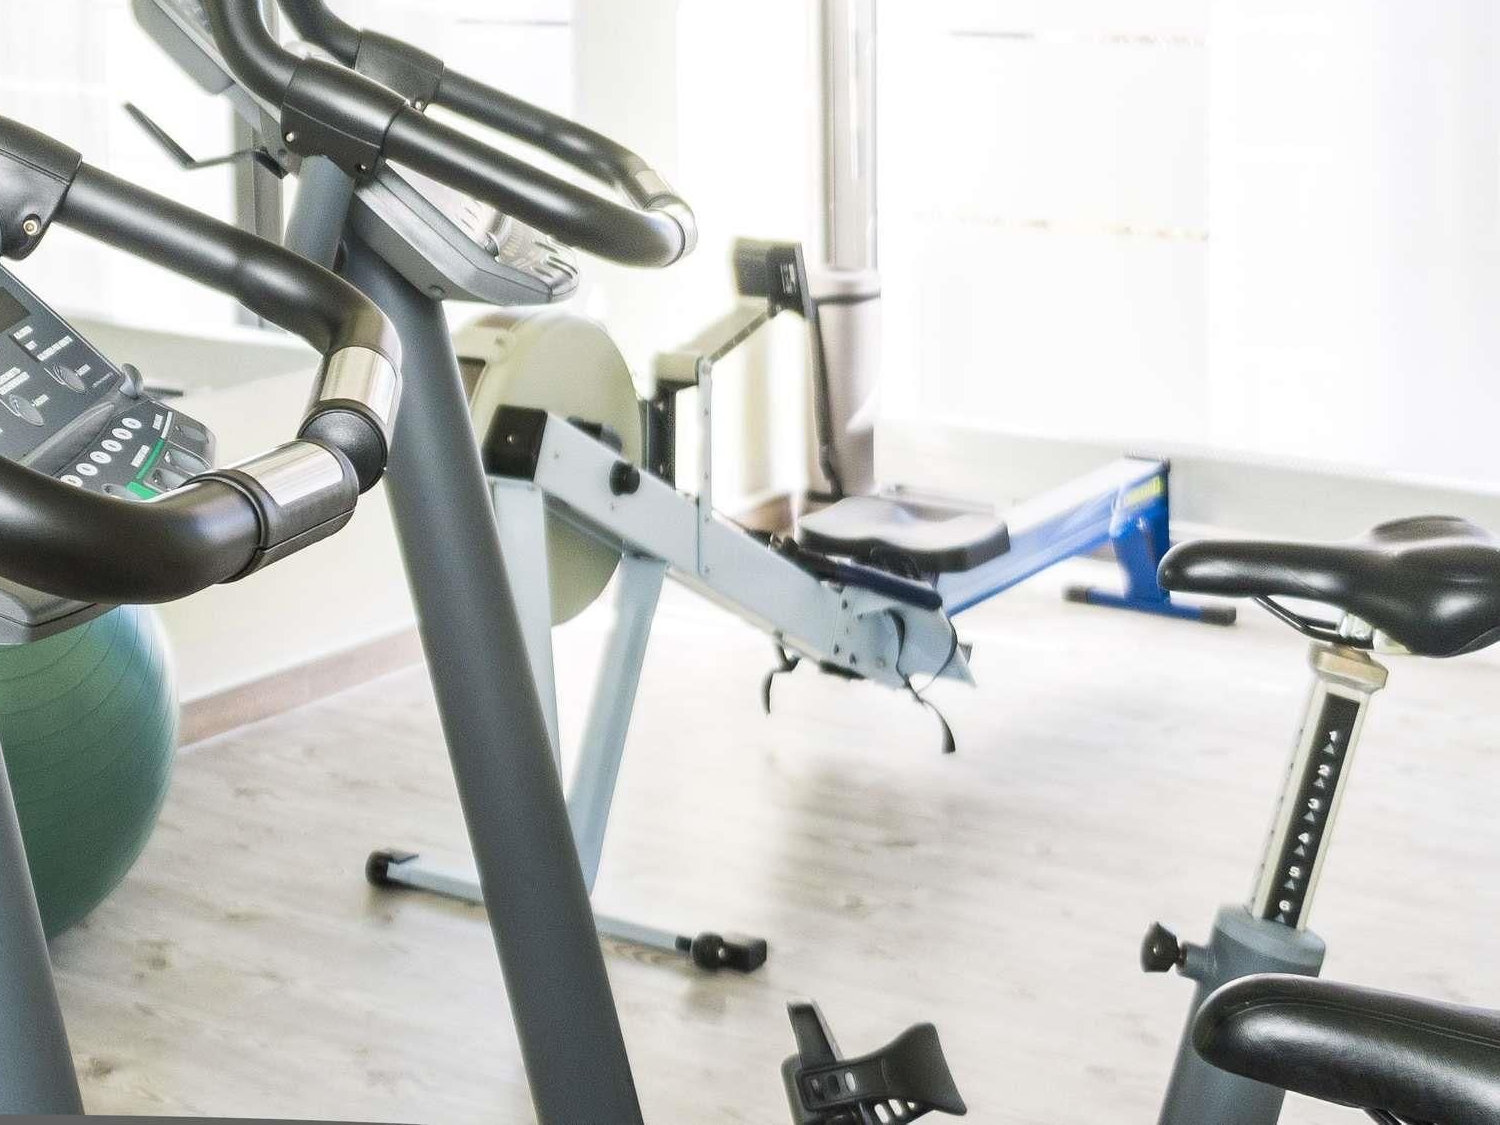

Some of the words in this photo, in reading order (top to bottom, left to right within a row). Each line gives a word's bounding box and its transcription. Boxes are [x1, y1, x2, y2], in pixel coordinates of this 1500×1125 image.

[1329, 730, 1338, 743] 1
[1317, 764, 1330, 776] 2
[1307, 798, 1319, 810] 3
[1288, 865, 1301, 878] 5
[1279, 899, 1291, 912] 6
